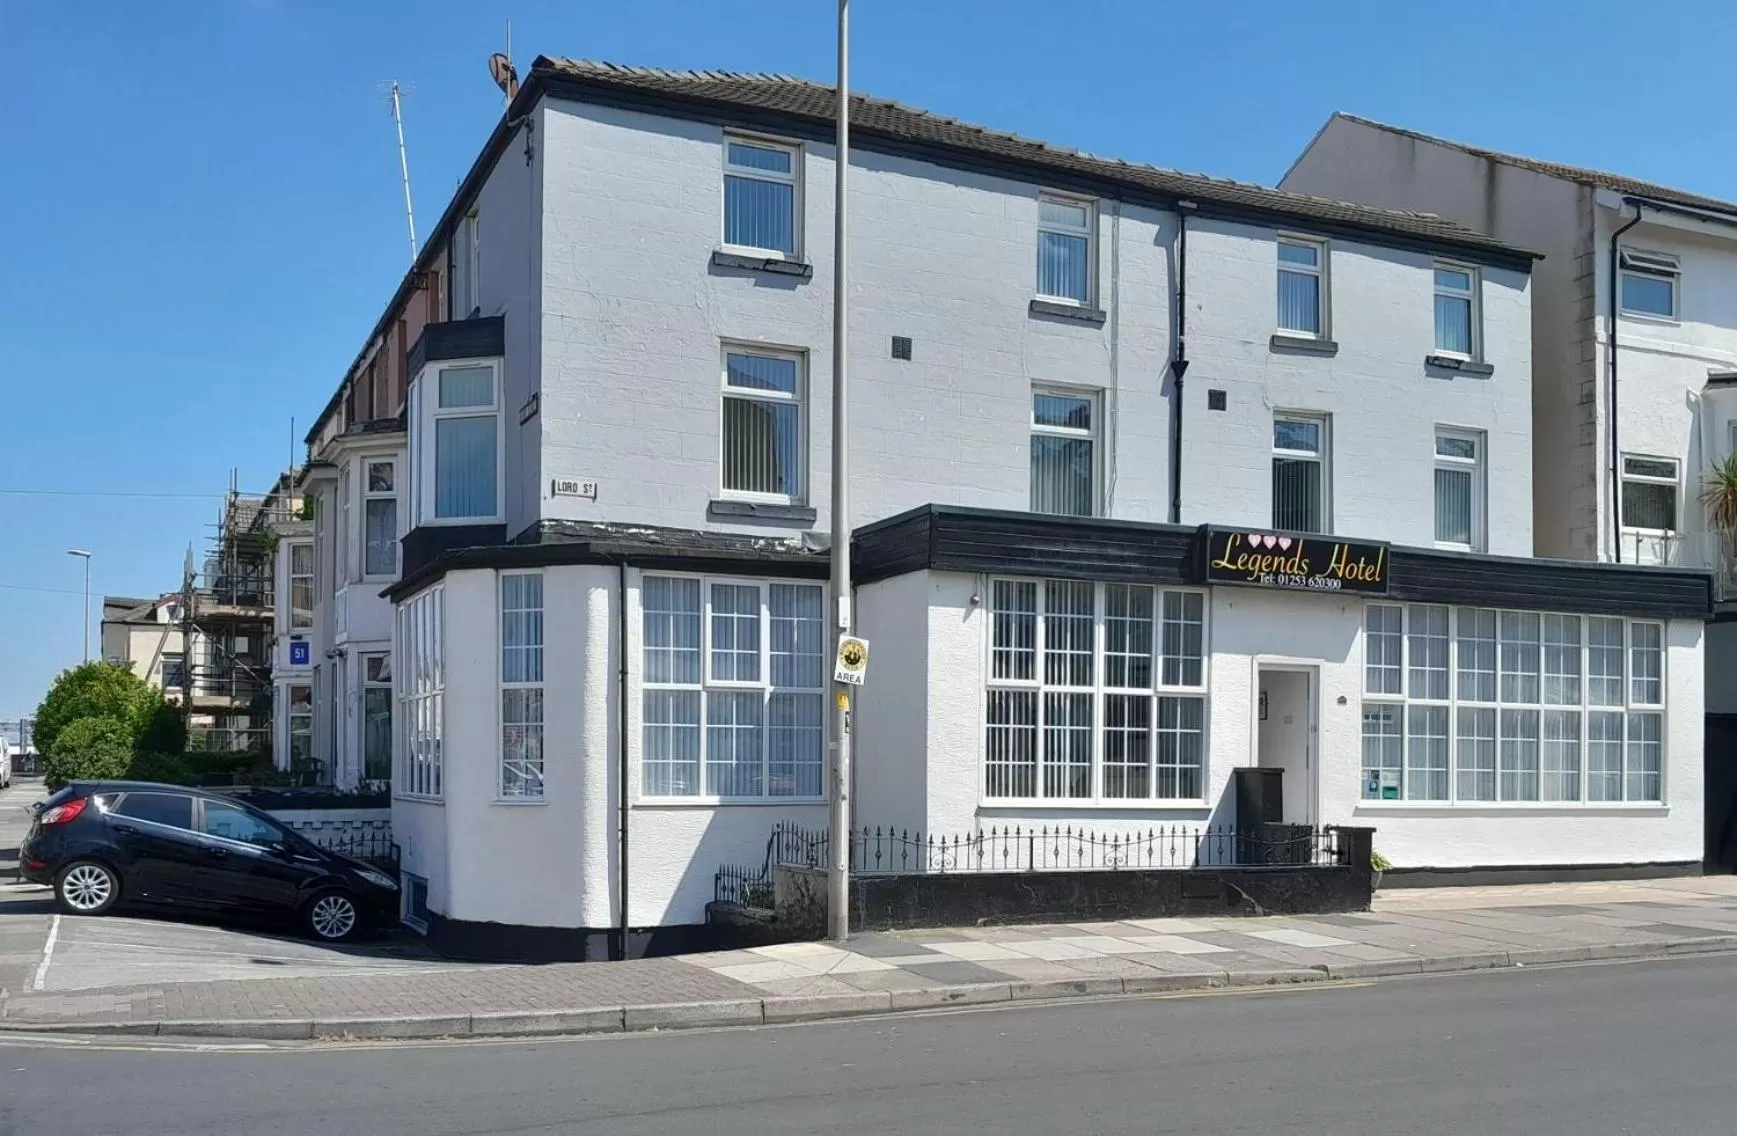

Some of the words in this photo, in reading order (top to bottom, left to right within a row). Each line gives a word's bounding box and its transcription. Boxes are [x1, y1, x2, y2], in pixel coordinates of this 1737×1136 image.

[557, 481, 578, 493] LORD
[1211, 533, 1310, 581] Legends
[1315, 543, 1385, 582] Hotel
[1258, 572, 1275, 585] Tel:
[1277, 573, 1306, 587] 01253
[1308, 577, 1342, 590] 620300
[294, 647, 305, 659] 51
[836, 671, 861, 683] AREA
